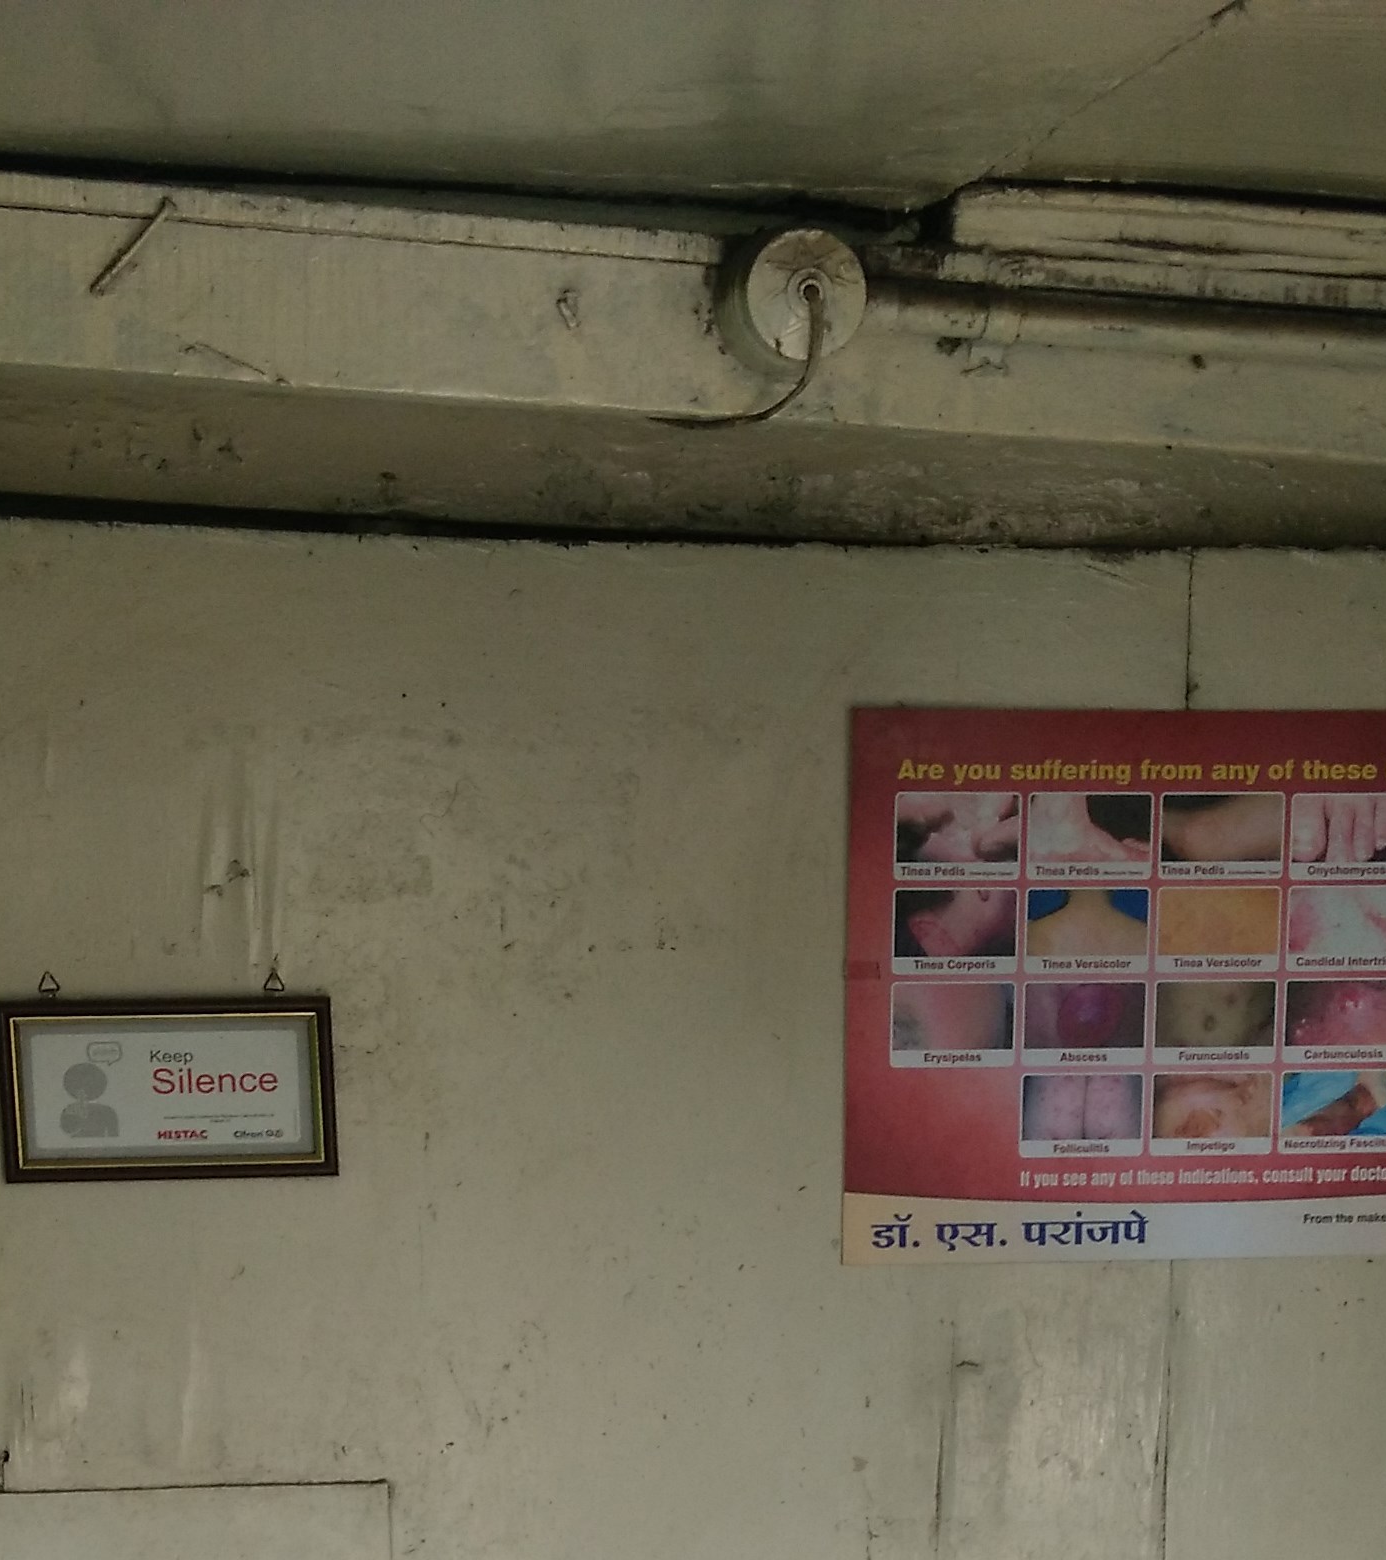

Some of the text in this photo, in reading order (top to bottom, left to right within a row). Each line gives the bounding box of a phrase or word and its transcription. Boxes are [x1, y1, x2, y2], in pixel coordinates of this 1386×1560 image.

[897, 758, 945, 781] Are
[953, 763, 1002, 786] you
[1010, 758, 1132, 785] suffering
[1140, 758, 1204, 781] from
[1211, 762, 1261, 785] any
[1267, 758, 1295, 781] of
[1302, 758, 1378, 781] these
[900, 865, 932, 877] Tinea
[934, 865, 966, 877] Pedis
[1035, 865, 1066, 877] Tinea
[1068, 865, 1100, 877] Pedis
[1161, 864, 1192, 876] Tinea
[1194, 864, 1226, 876] Pedis
[913, 959, 997, 971] Tinea Corporis
[1041, 958, 1132, 969] Tinea Versicolor
[1173, 957, 1263, 968] Tinea Versicolor
[1295, 956, 1347, 967] Candidal
[149, 1049, 194, 1065] Keep
[923, 1052, 982, 1064] Erysipelas
[1060, 1052, 1108, 1063] Abscess
[1178, 1050, 1251, 1061] Furunculosis
[1303, 1048, 1384, 1060] Carbunculosis
[152, 1067, 279, 1094] Silence
[157, 1129, 209, 1140] HISTAC
[1020, 1170, 1030, 1187] If
[1033, 1172, 1059, 1189] you
[1062, 1172, 1088, 1187] see
[1090, 1171, 1117, 1188] any
[1119, 1170, 1134, 1186] of
[1136, 1169, 1175, 1186] these
[1178, 1168, 1259, 1185] indications,
[1262, 1167, 1314, 1184] consult
[1316, 1168, 1348, 1185] your
[1302, 1212, 1334, 1225] From
[1335, 1212, 1354, 1224] the
[870, 1209, 1150, 1252] डॉ. एस. परांजपे
